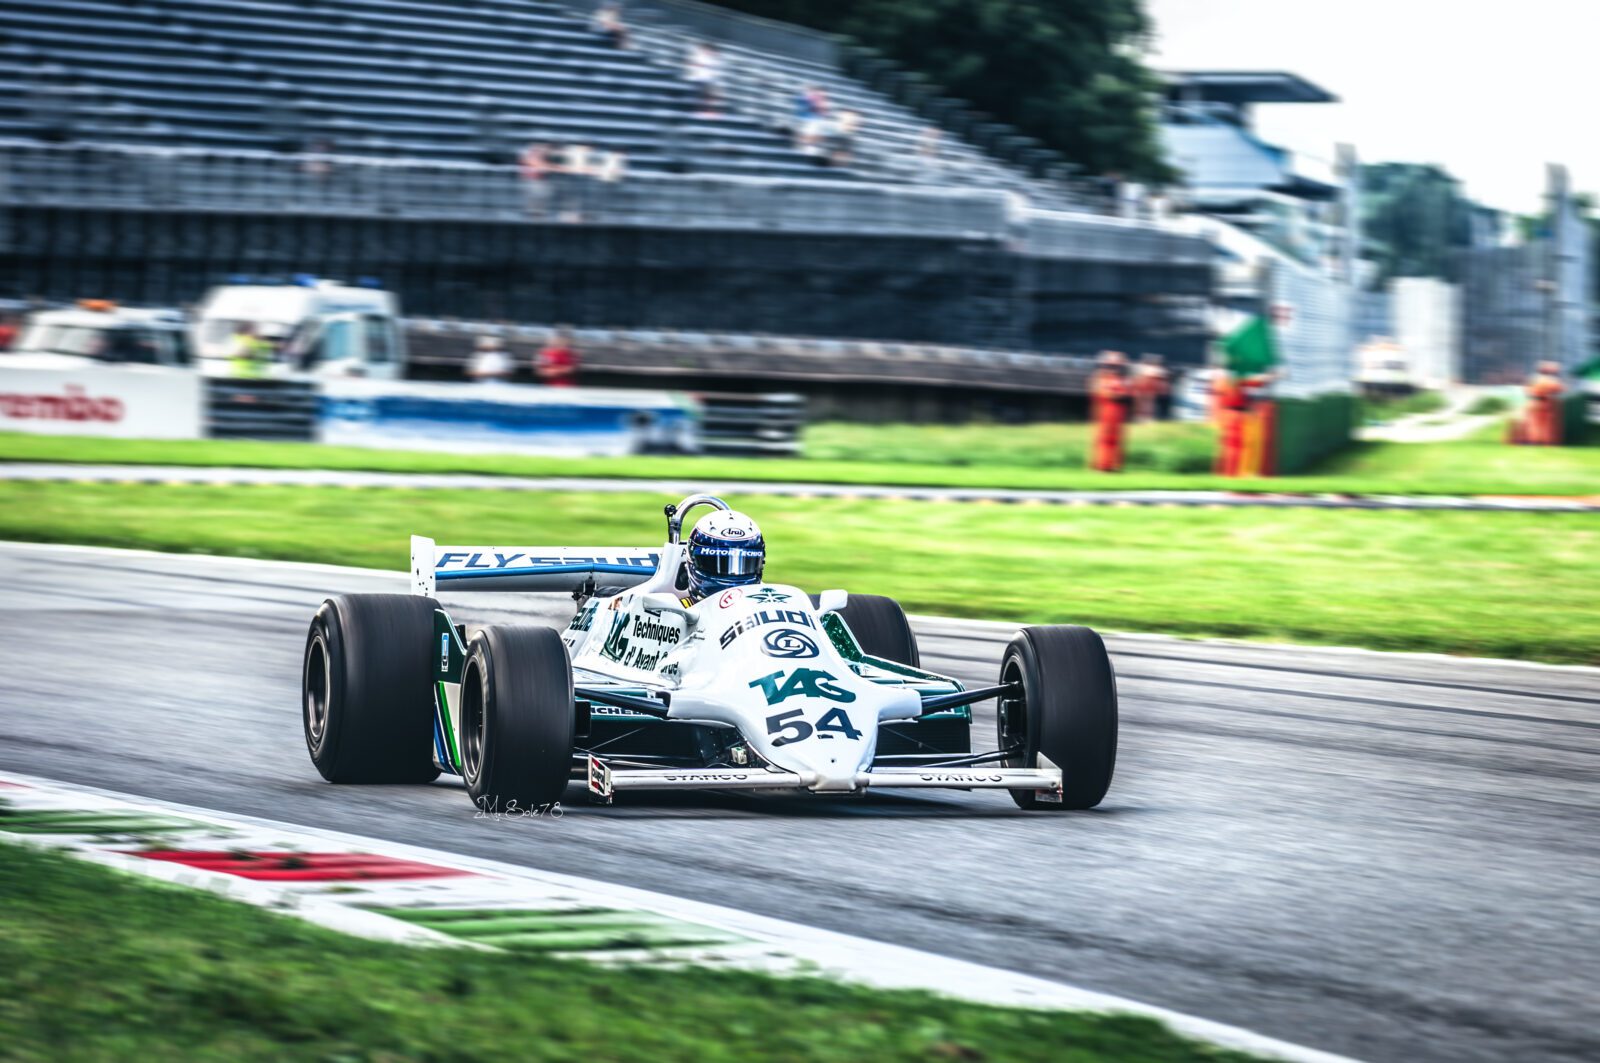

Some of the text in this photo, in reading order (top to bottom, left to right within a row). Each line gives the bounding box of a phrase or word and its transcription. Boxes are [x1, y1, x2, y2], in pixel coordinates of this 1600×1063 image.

[727, 528, 742, 536] Arai
[436, 553, 525, 568] FLY
[633, 615, 681, 646] Techniques
[633, 648, 660, 672] Avant
[749, 668, 857, 706] TAG
[765, 707, 863, 747] 54
